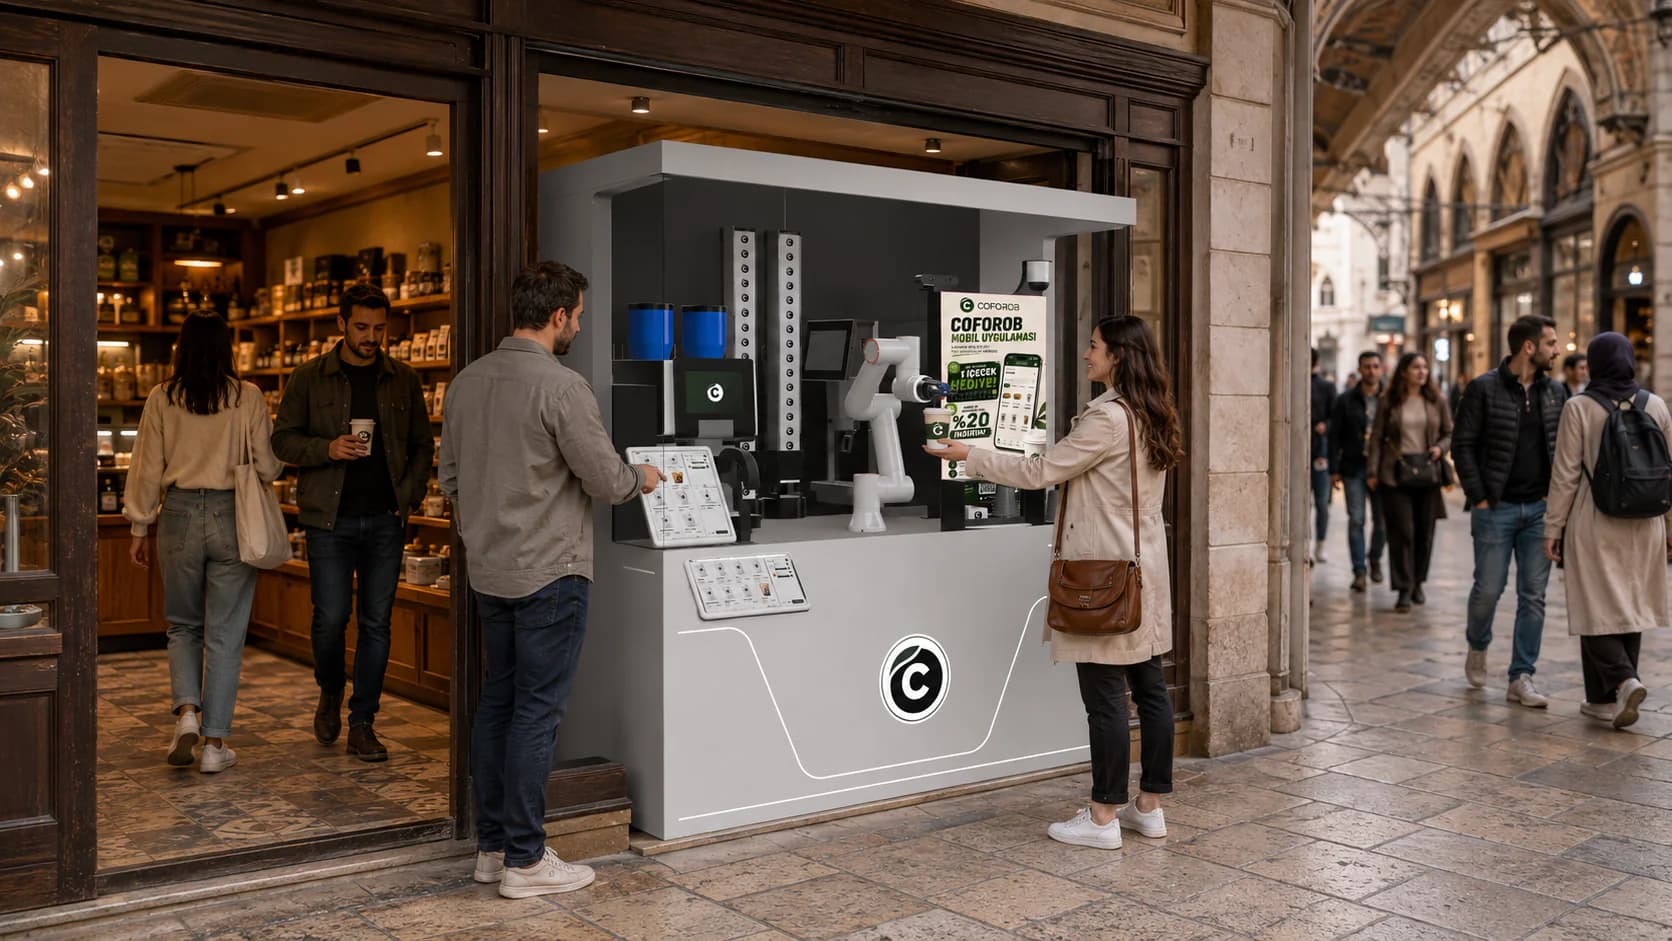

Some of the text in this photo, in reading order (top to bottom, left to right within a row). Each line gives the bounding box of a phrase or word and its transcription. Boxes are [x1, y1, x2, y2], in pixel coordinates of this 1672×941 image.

[951, 316, 1023, 332] COFOROB
[952, 333, 980, 342] MOBIL
[952, 412, 990, 429] %20
[902, 662, 930, 700] C
